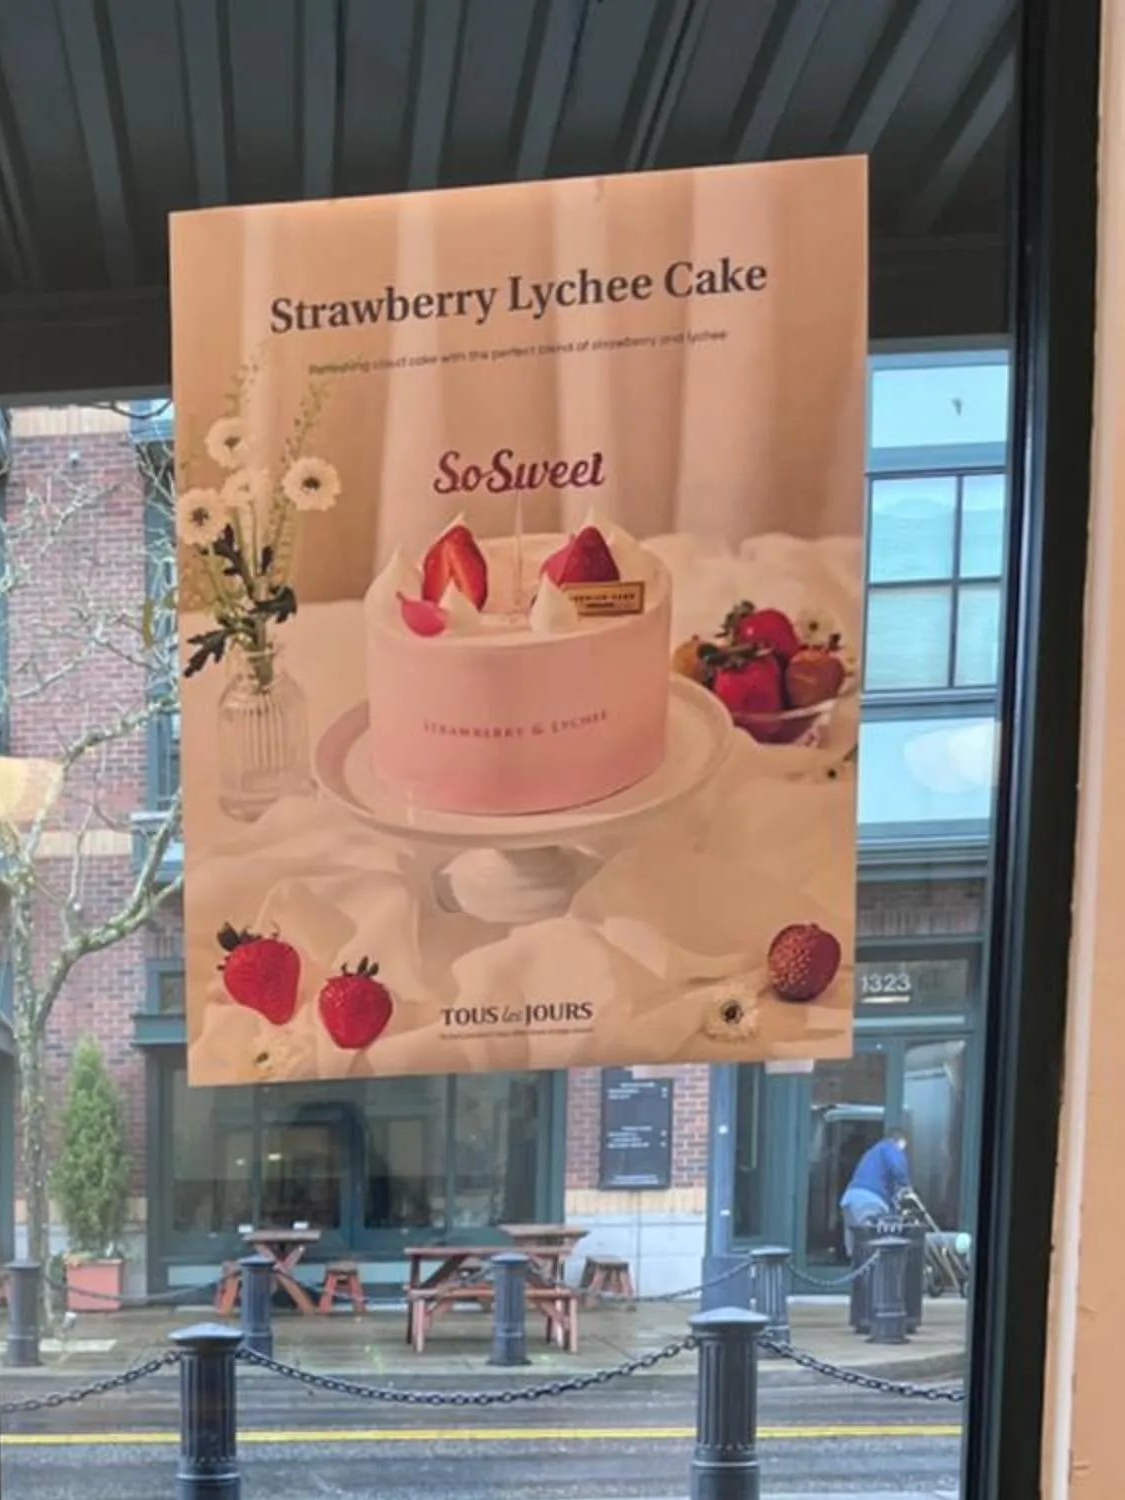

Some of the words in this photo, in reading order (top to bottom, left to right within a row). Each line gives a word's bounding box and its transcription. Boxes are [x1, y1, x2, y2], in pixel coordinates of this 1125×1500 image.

[270, 285, 499, 334] Strawberry
[507, 268, 653, 320] Lychee
[663, 256, 768, 300] Cake
[861, 973, 912, 993] 1323
[440, 1006, 500, 1027] TOUS
[525, 1001, 595, 1026] JOURS
